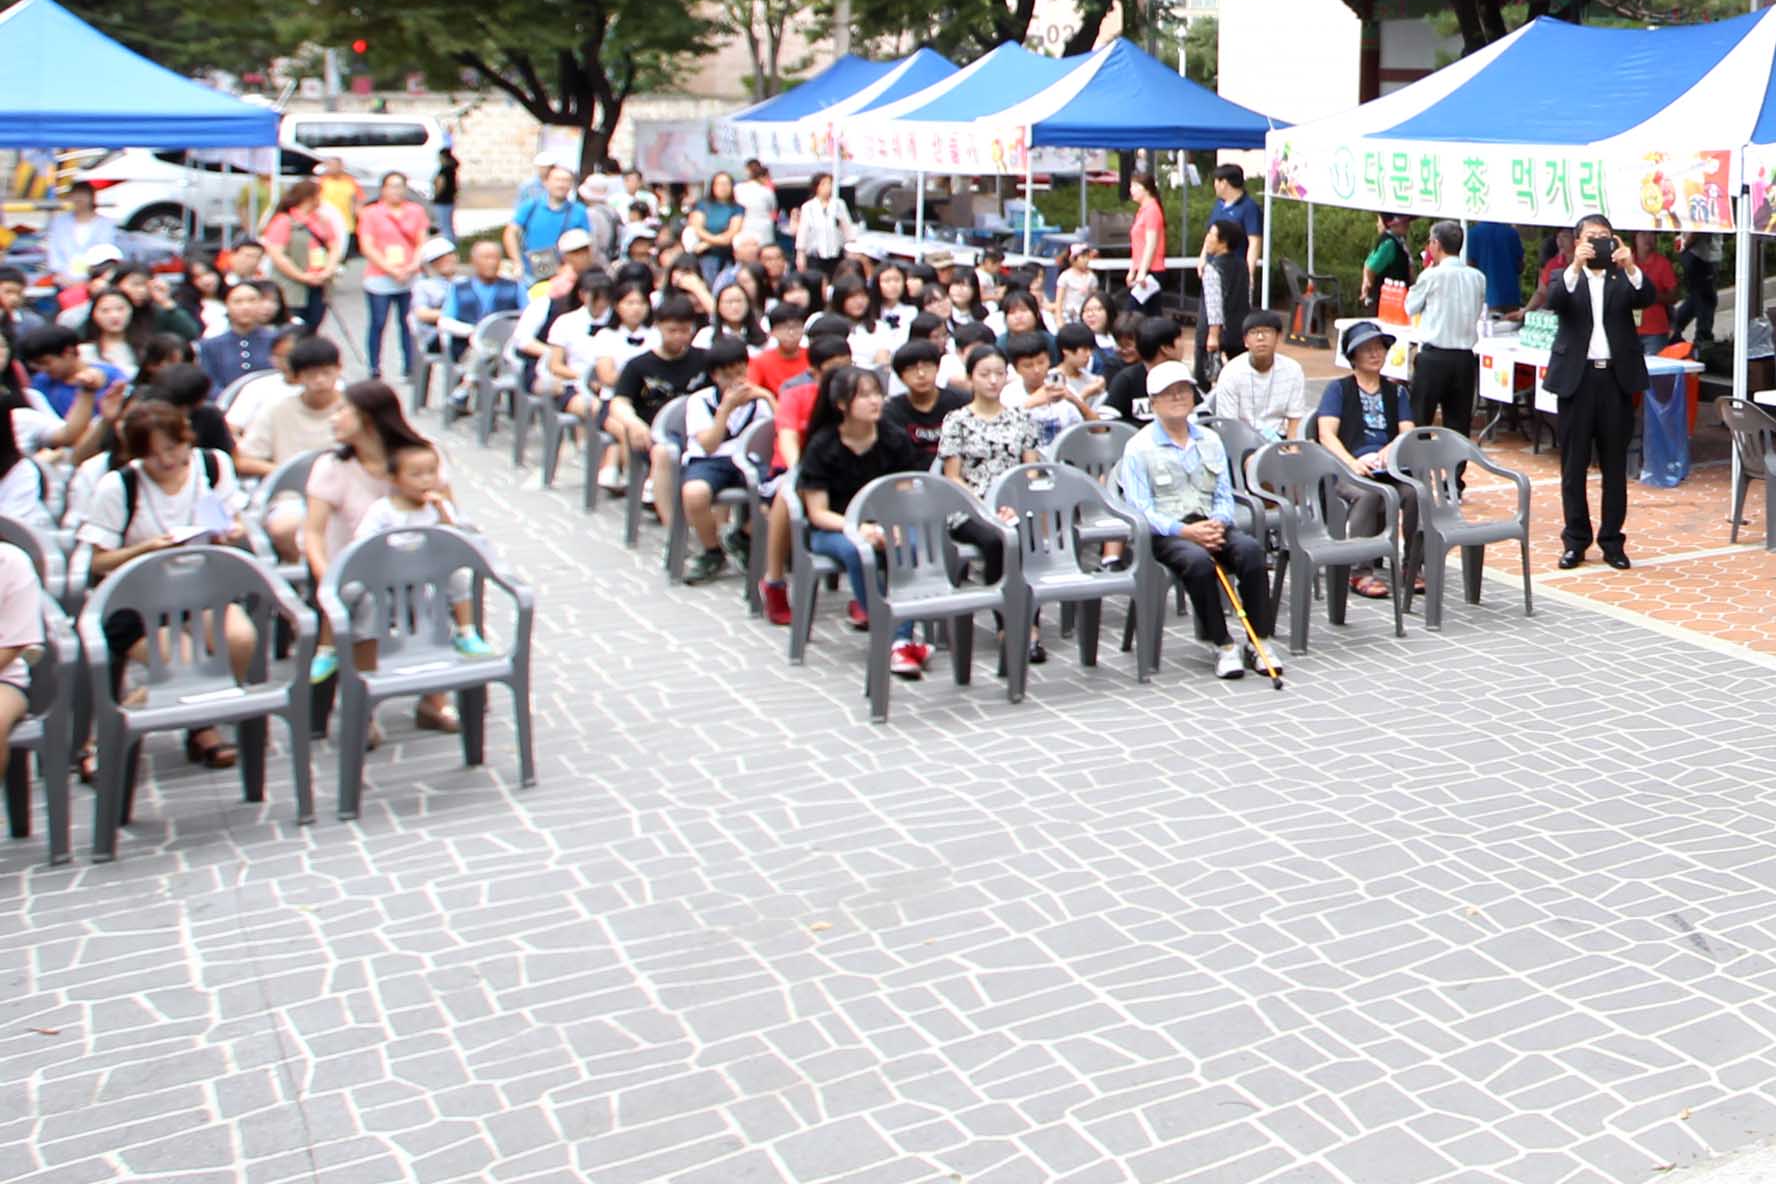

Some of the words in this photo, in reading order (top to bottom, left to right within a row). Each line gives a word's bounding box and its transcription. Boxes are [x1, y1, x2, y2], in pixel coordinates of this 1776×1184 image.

[1364, 150, 1442, 210] 다문화
[1463, 157, 1488, 213] 茶
[1511, 157, 1608, 218] 먹거리
